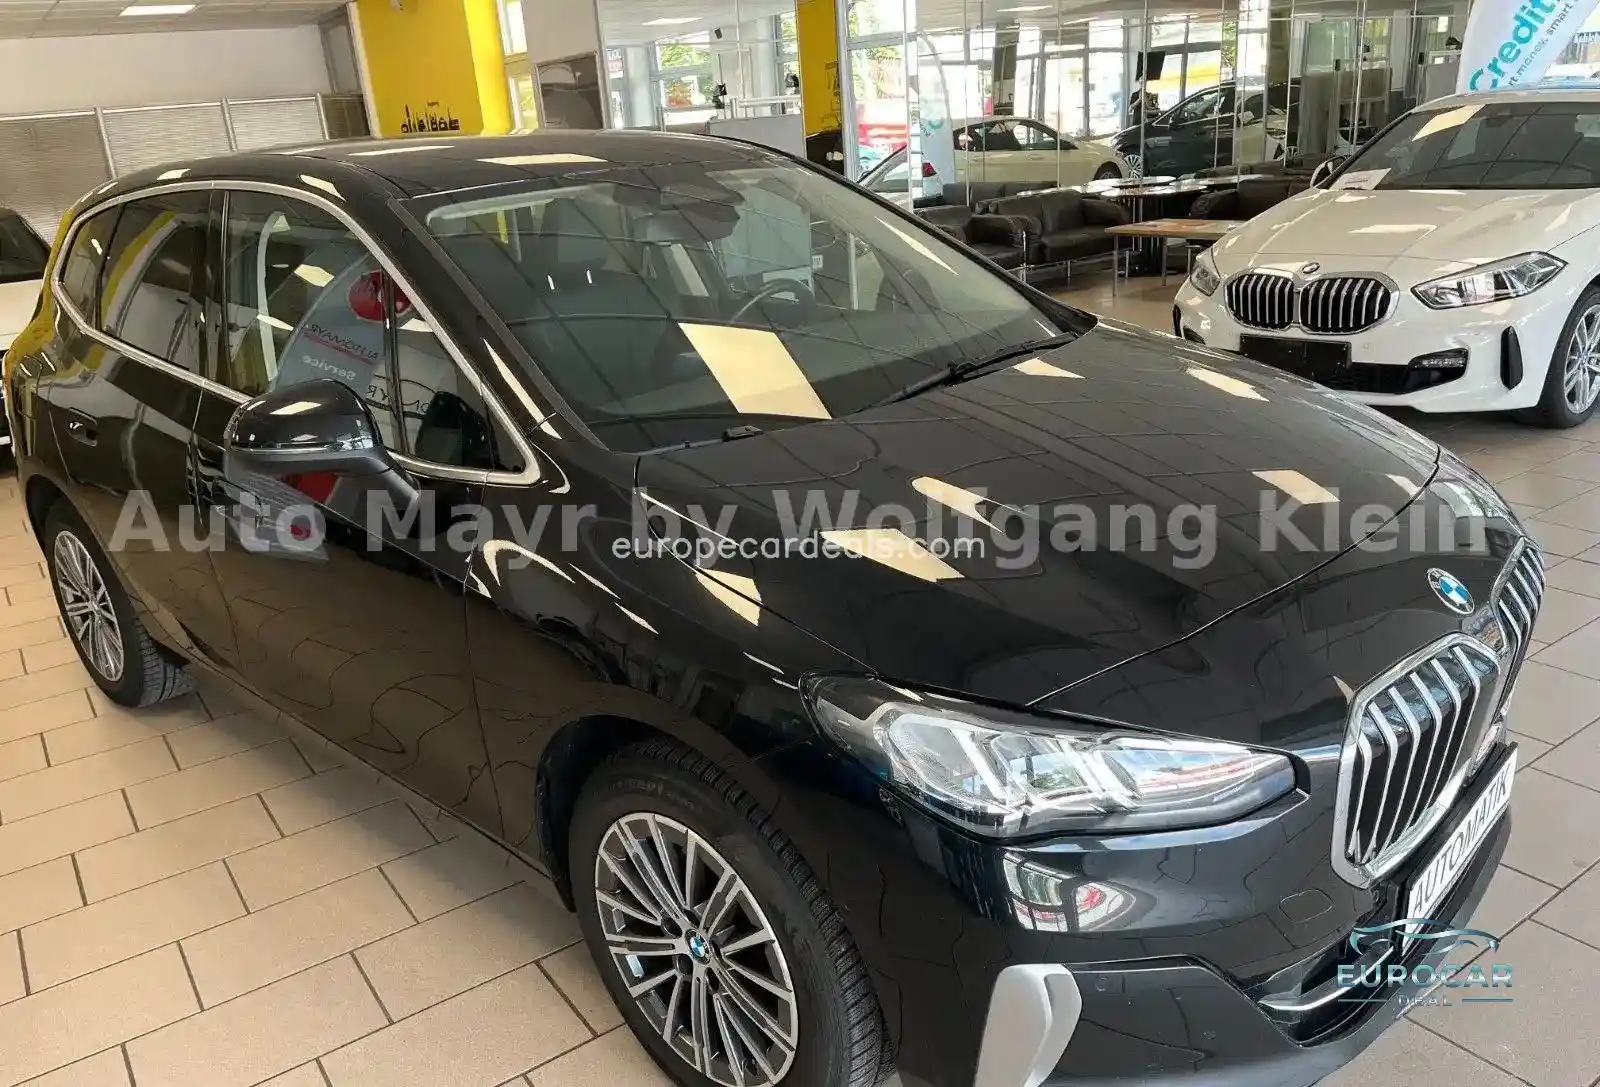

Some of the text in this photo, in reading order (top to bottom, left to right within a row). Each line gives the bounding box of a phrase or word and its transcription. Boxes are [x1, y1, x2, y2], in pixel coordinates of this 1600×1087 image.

[1508, 76, 1519, 87] rt
[1546, 3, 1574, 36] smart
[1412, 763, 1511, 918] AUTOMATIK
